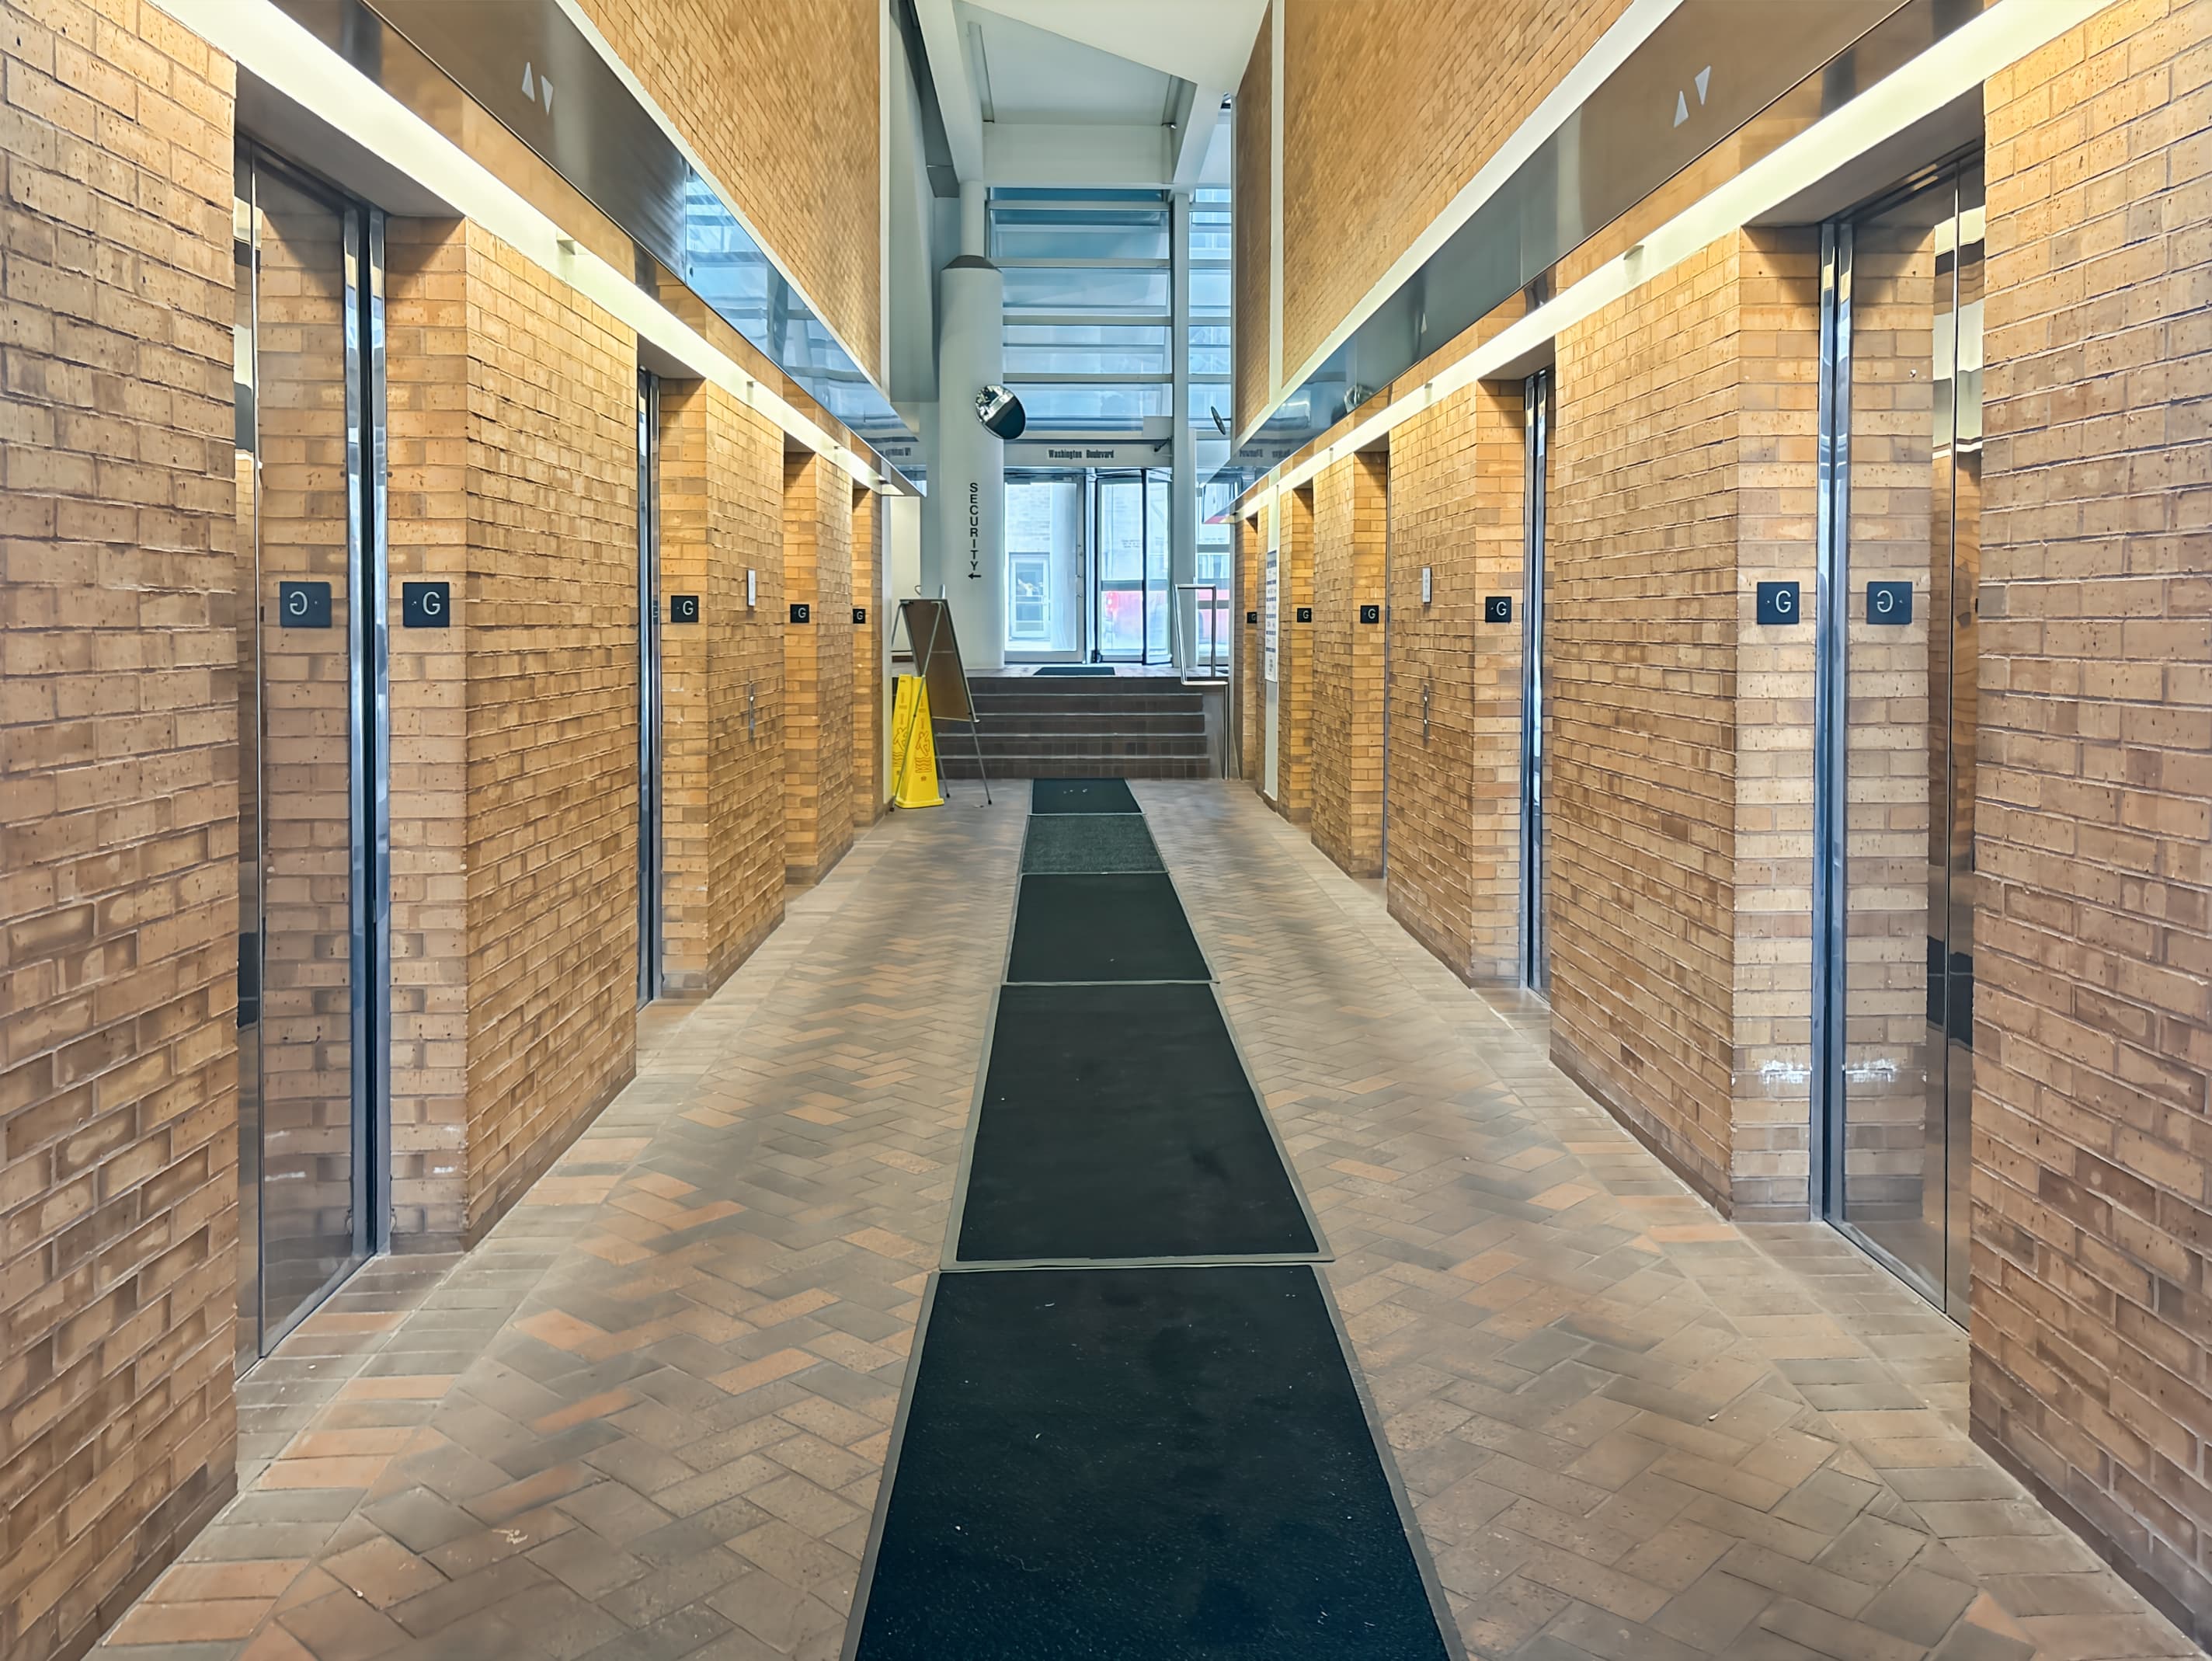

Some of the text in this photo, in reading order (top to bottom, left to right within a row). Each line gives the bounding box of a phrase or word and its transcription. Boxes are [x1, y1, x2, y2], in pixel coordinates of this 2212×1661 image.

[1048, 449, 1082, 459] Washington
[969, 482, 979, 571] SECURITY
[423, 591, 440, 615] G
[1776, 590, 1792, 613] G
[683, 601, 694, 615] G
[798, 608, 806, 618] G
[1368, 608, 1376, 619] G
[1496, 601, 1507, 616] G
[857, 611, 863, 620] G
[1303, 610, 1309, 620] G
